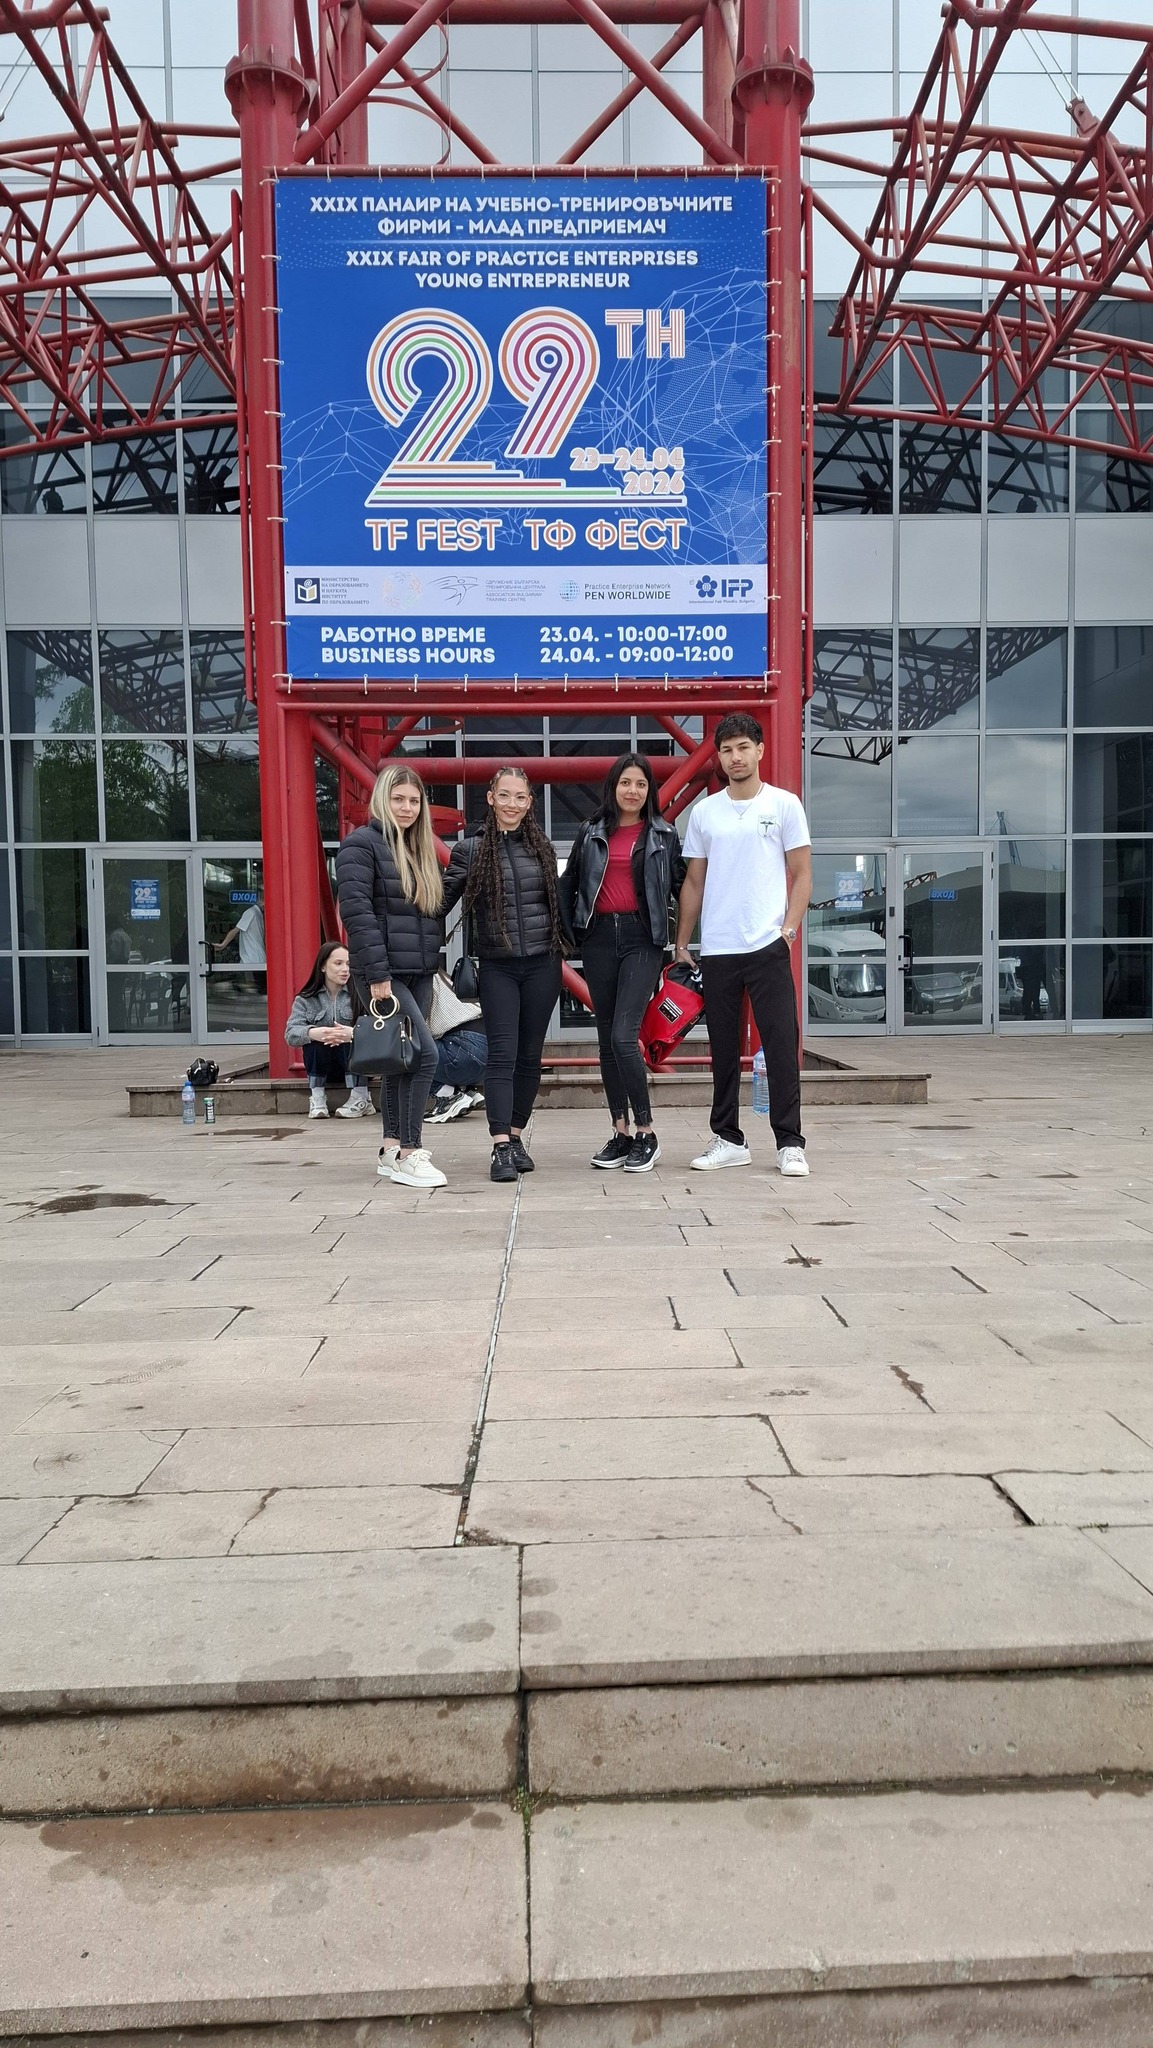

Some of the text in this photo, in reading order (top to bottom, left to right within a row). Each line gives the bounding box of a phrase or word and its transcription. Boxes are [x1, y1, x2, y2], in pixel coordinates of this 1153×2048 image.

[362, 196, 442, 212] ПАНАИР
[445, 196, 473, 212] НА
[475, 196, 733, 212] УЧЕБНО-ТРЕНИРОВЪЧНИТЕ
[377, 217, 451, 236] ФИРМИ
[468, 218, 525, 237] МЛАД
[528, 218, 666, 237] ПРЕДПРИЕМАЧ
[346, 250, 699, 266] XXIX FAIR OF PRACTICE ENTERPRISES
[415, 272, 631, 288] YOUNG ENTREPRENEUR
[622, 471, 685, 495] 2026
[364, 518, 503, 552] TF FEST
[523, 517, 687, 552] ТФ ФЕСТ
[584, 590, 671, 600] PEN WORLDWIDE
[611, 583, 644, 591] Enterprise
[721, 578, 754, 598] IFP
[321, 626, 486, 643] РАБОТНО ВРЕМЕ
[540, 626, 600, 643] 23.04.
[617, 625, 728, 642] 10:00-17:00
[321, 647, 496, 664] BUSINESS HOURS
[540, 646, 600, 663] 24.04.
[619, 645, 734, 663] 09:00-12:00
[232, 892, 257, 903] ВХОД
[931, 890, 956, 900] ВХОД
